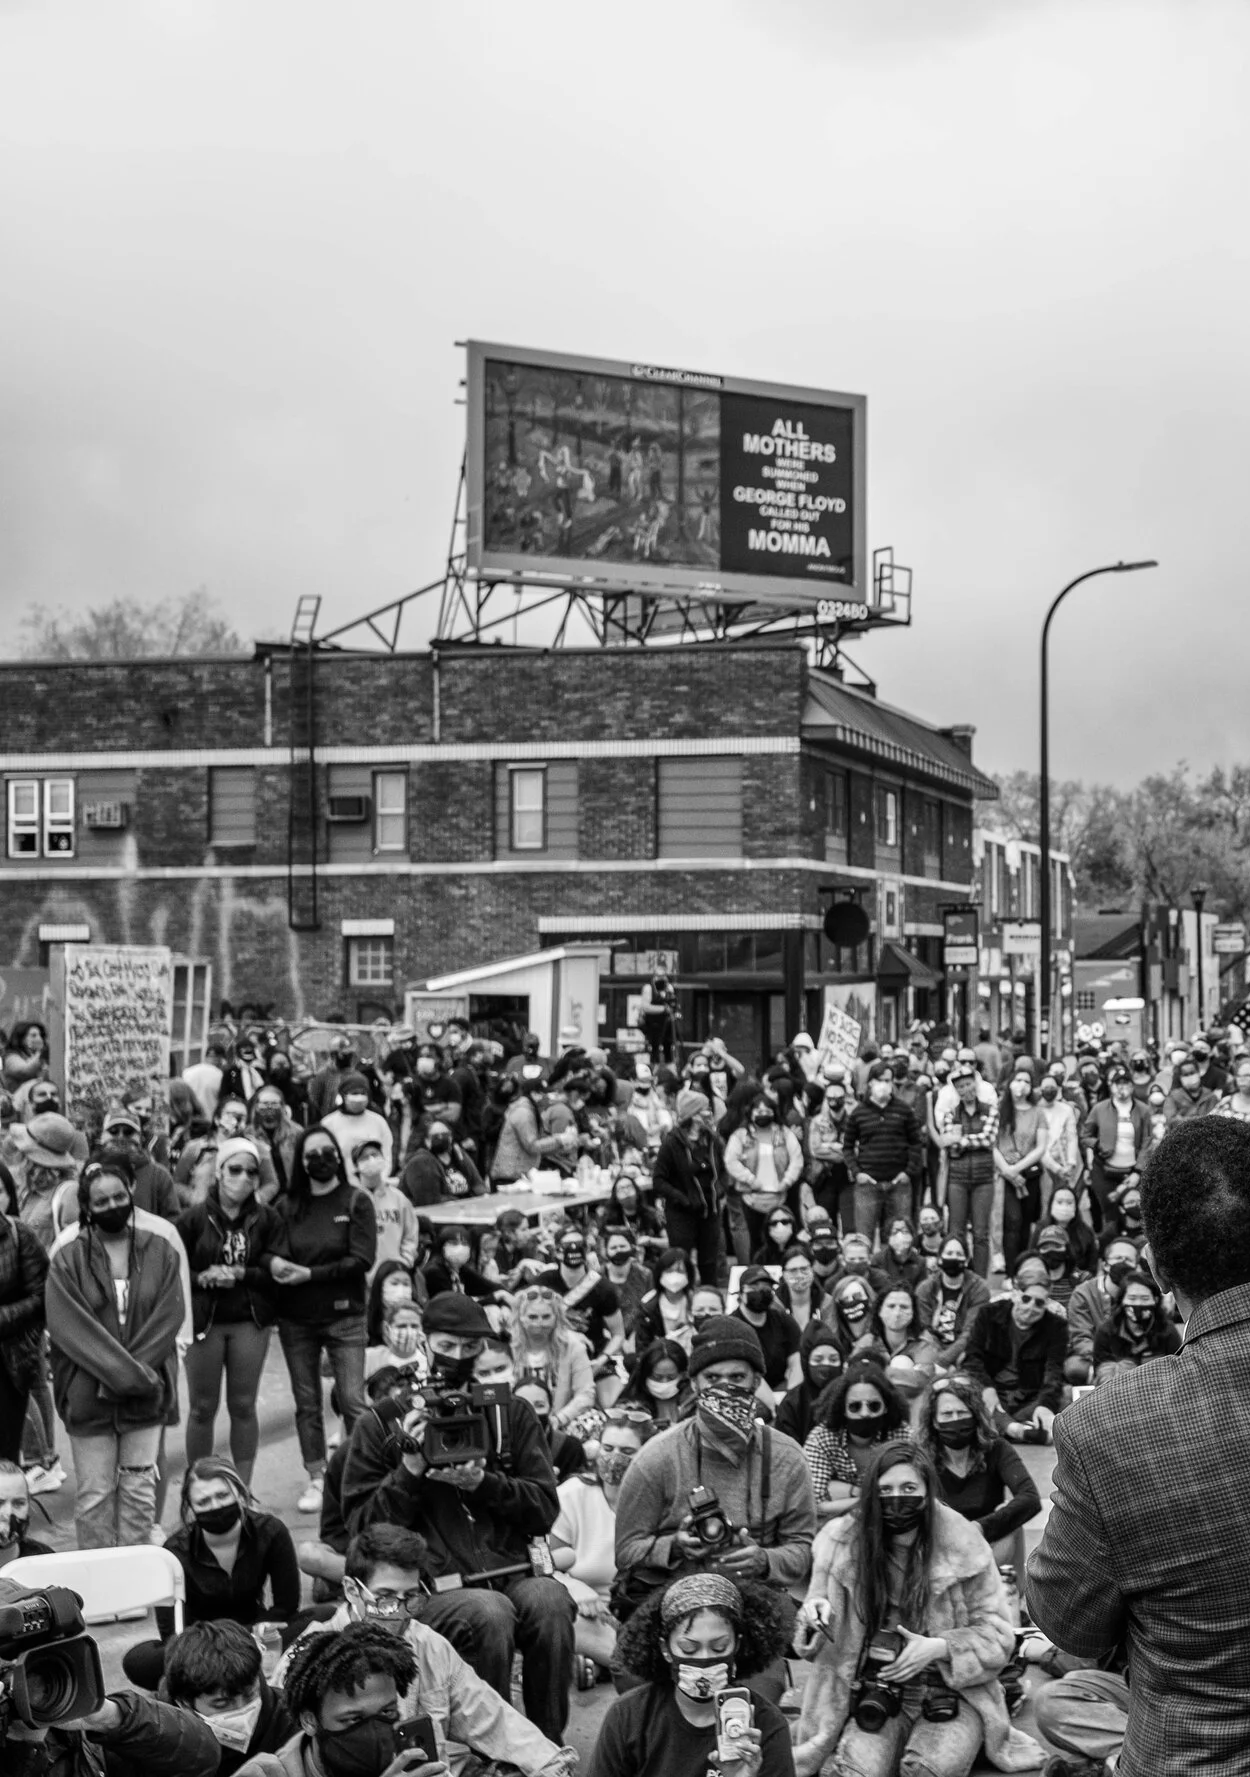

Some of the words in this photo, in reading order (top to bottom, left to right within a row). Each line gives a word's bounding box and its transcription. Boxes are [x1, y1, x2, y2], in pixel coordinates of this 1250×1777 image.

[771, 418, 810, 441] ALL
[743, 432, 836, 463] MOTHERS
[775, 457, 805, 471] WERE
[761, 465, 819, 484] SUMMONED
[775, 479, 806, 493] WHEN
[733, 485, 796, 507] GEORGE
[798, 493, 846, 513] FLOYD
[759, 504, 799, 520] CALLED
[800, 508, 821, 522] OUT
[770, 518, 792, 531] FOR
[793, 521, 810, 533] HIS
[748, 528, 831, 558] MOMMA
